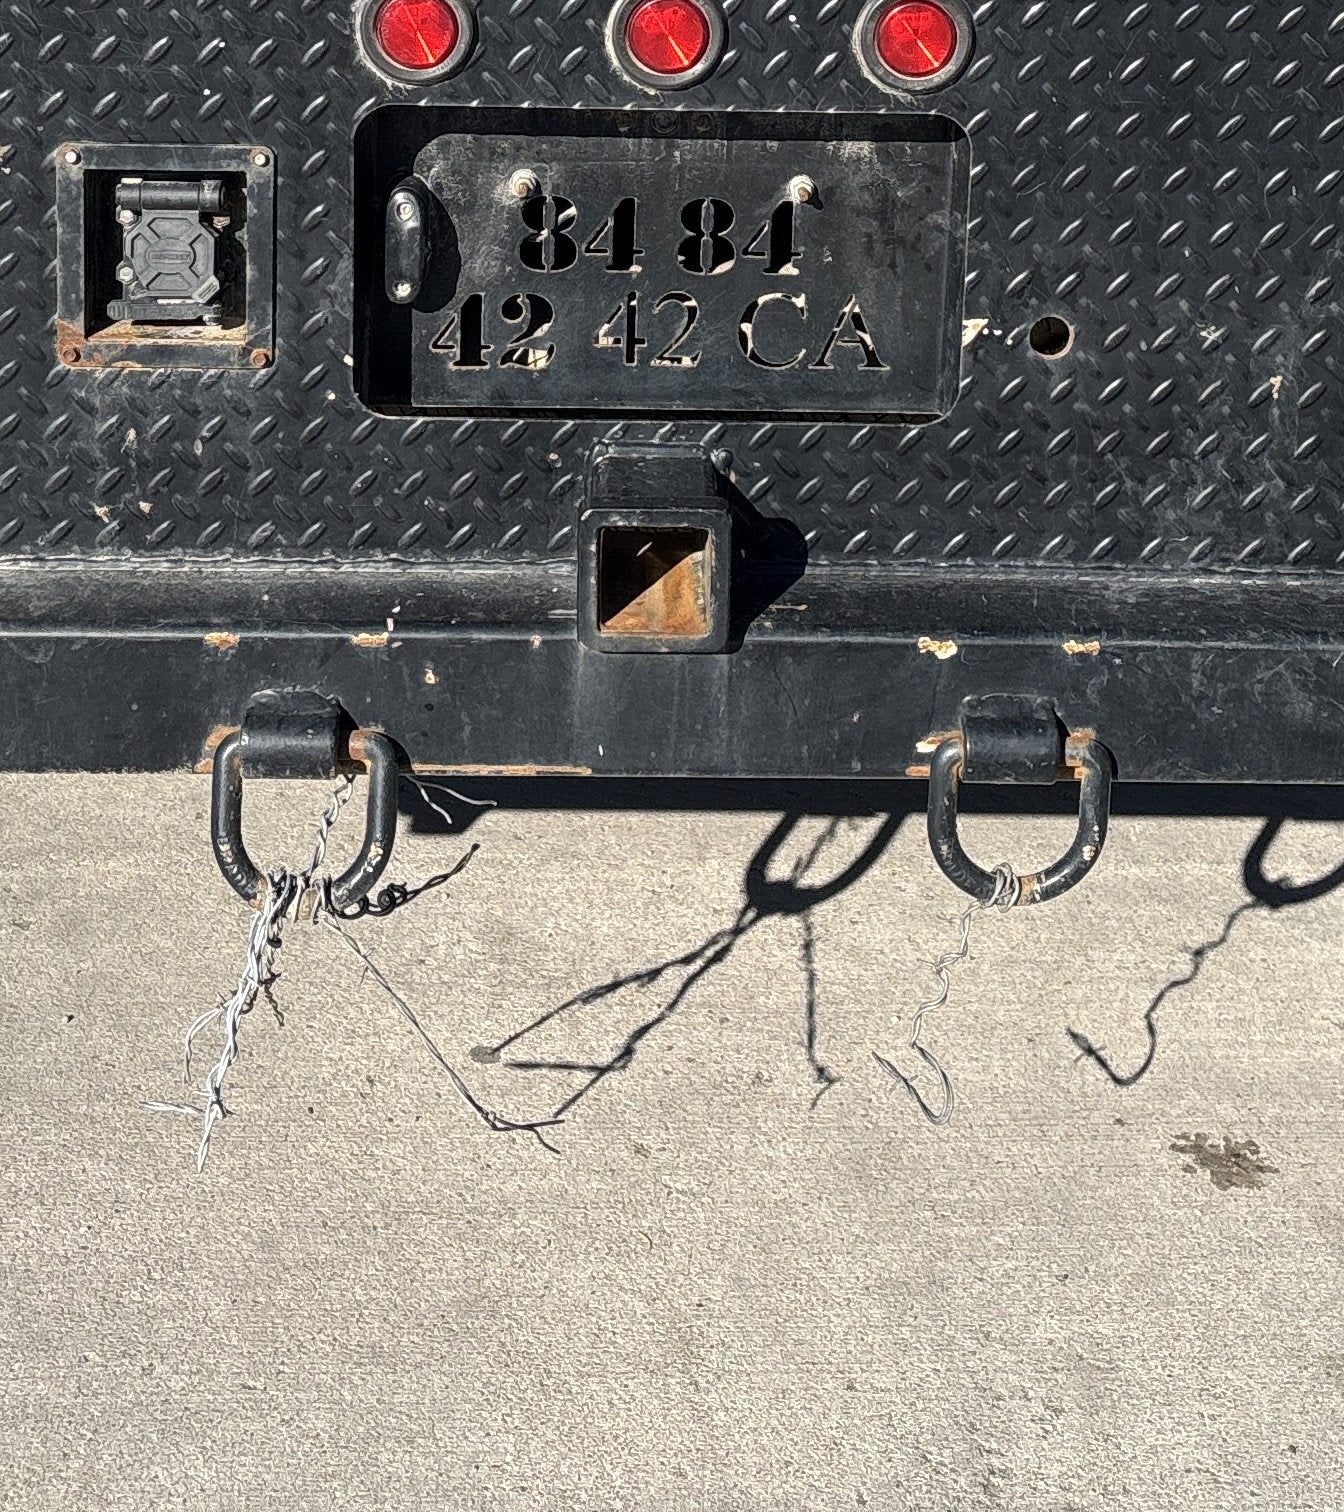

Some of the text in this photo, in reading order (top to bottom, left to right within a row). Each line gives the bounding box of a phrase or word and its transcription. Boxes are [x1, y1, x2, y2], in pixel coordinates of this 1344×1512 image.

[518, 194, 804, 276] 84 84
[428, 290, 891, 371] 42 42 CA
